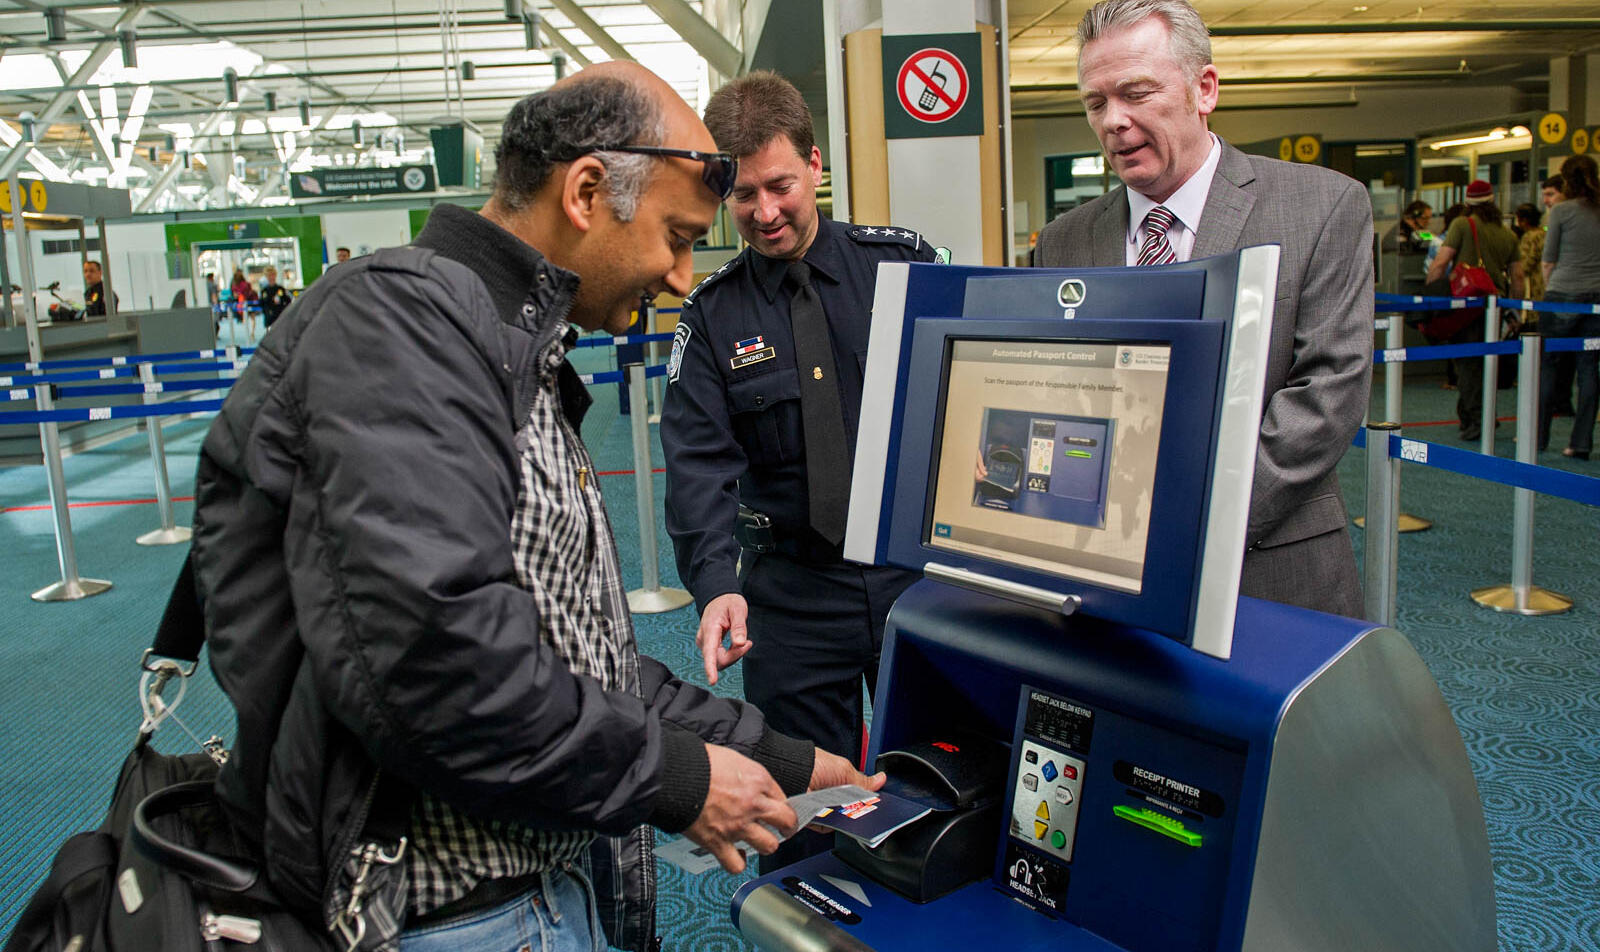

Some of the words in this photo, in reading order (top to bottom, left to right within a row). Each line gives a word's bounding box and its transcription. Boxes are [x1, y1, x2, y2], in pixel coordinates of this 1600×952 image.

[1545, 122, 1560, 136] 14
[325, 182, 358, 191] Welcome
[381, 179, 398, 188] USA
[740, 352, 764, 364] WAGNER
[992, 348, 1032, 359] Automated
[1033, 350, 1066, 361] Passport
[1066, 350, 1096, 361] Control
[984, 376, 996, 384] Scan
[996, 377, 1005, 385] the
[1005, 378, 1028, 387] passport
[1035, 379, 1045, 387] the
[1400, 445, 1426, 464] YVR
[1031, 692, 1049, 704] HEADSET
[1049, 698, 1060, 708] JACK
[1060, 701, 1075, 713] BELOW
[1074, 706, 1092, 719] KEYPAD
[1133, 766, 1166, 785] RECEIPT
[1166, 778, 1200, 798] PRINTER
[798, 881, 830, 901] DOCUMENT
[826, 898, 852, 916] READER
[1038, 895, 1056, 909] JACK
